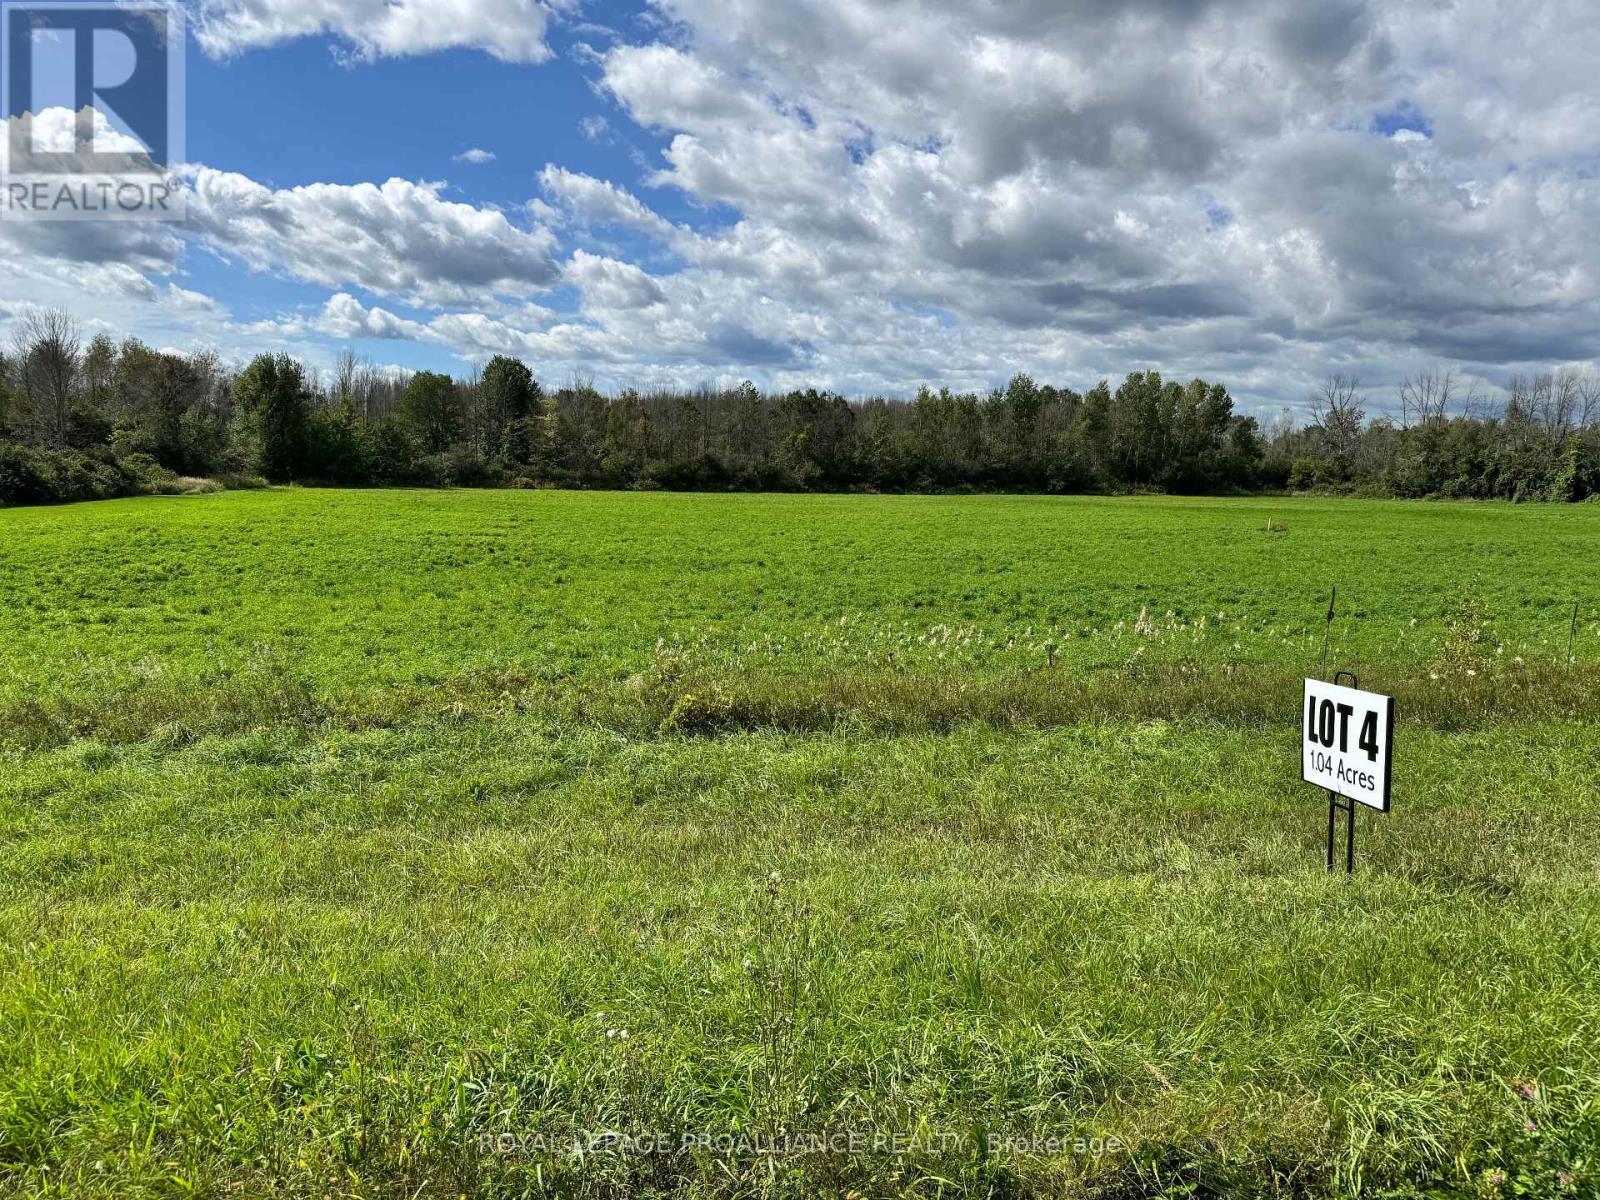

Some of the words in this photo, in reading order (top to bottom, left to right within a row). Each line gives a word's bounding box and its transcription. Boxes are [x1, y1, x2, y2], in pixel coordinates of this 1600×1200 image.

[1309, 695, 1353, 753] LOT
[1359, 710, 1378, 762] 4
[1311, 750, 1333, 776] 1.04
[1337, 758, 1375, 791] Acres
